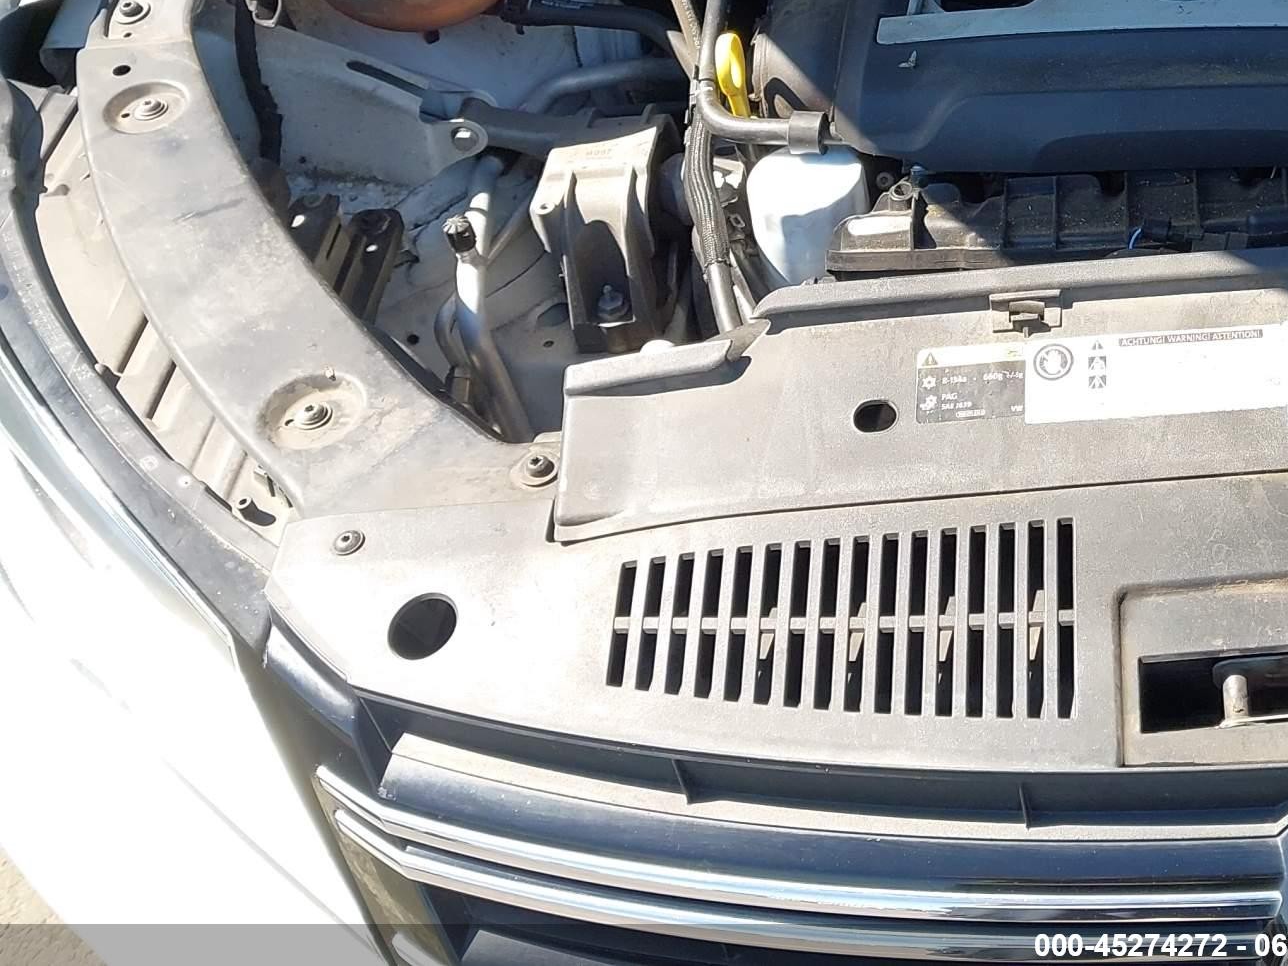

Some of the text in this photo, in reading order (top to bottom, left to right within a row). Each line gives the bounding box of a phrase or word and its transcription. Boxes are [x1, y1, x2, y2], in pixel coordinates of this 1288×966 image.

[1121, 335, 1165, 346] ACHTUNG!
[1167, 332, 1211, 343] WARNING!
[941, 393, 958, 401] PAG
